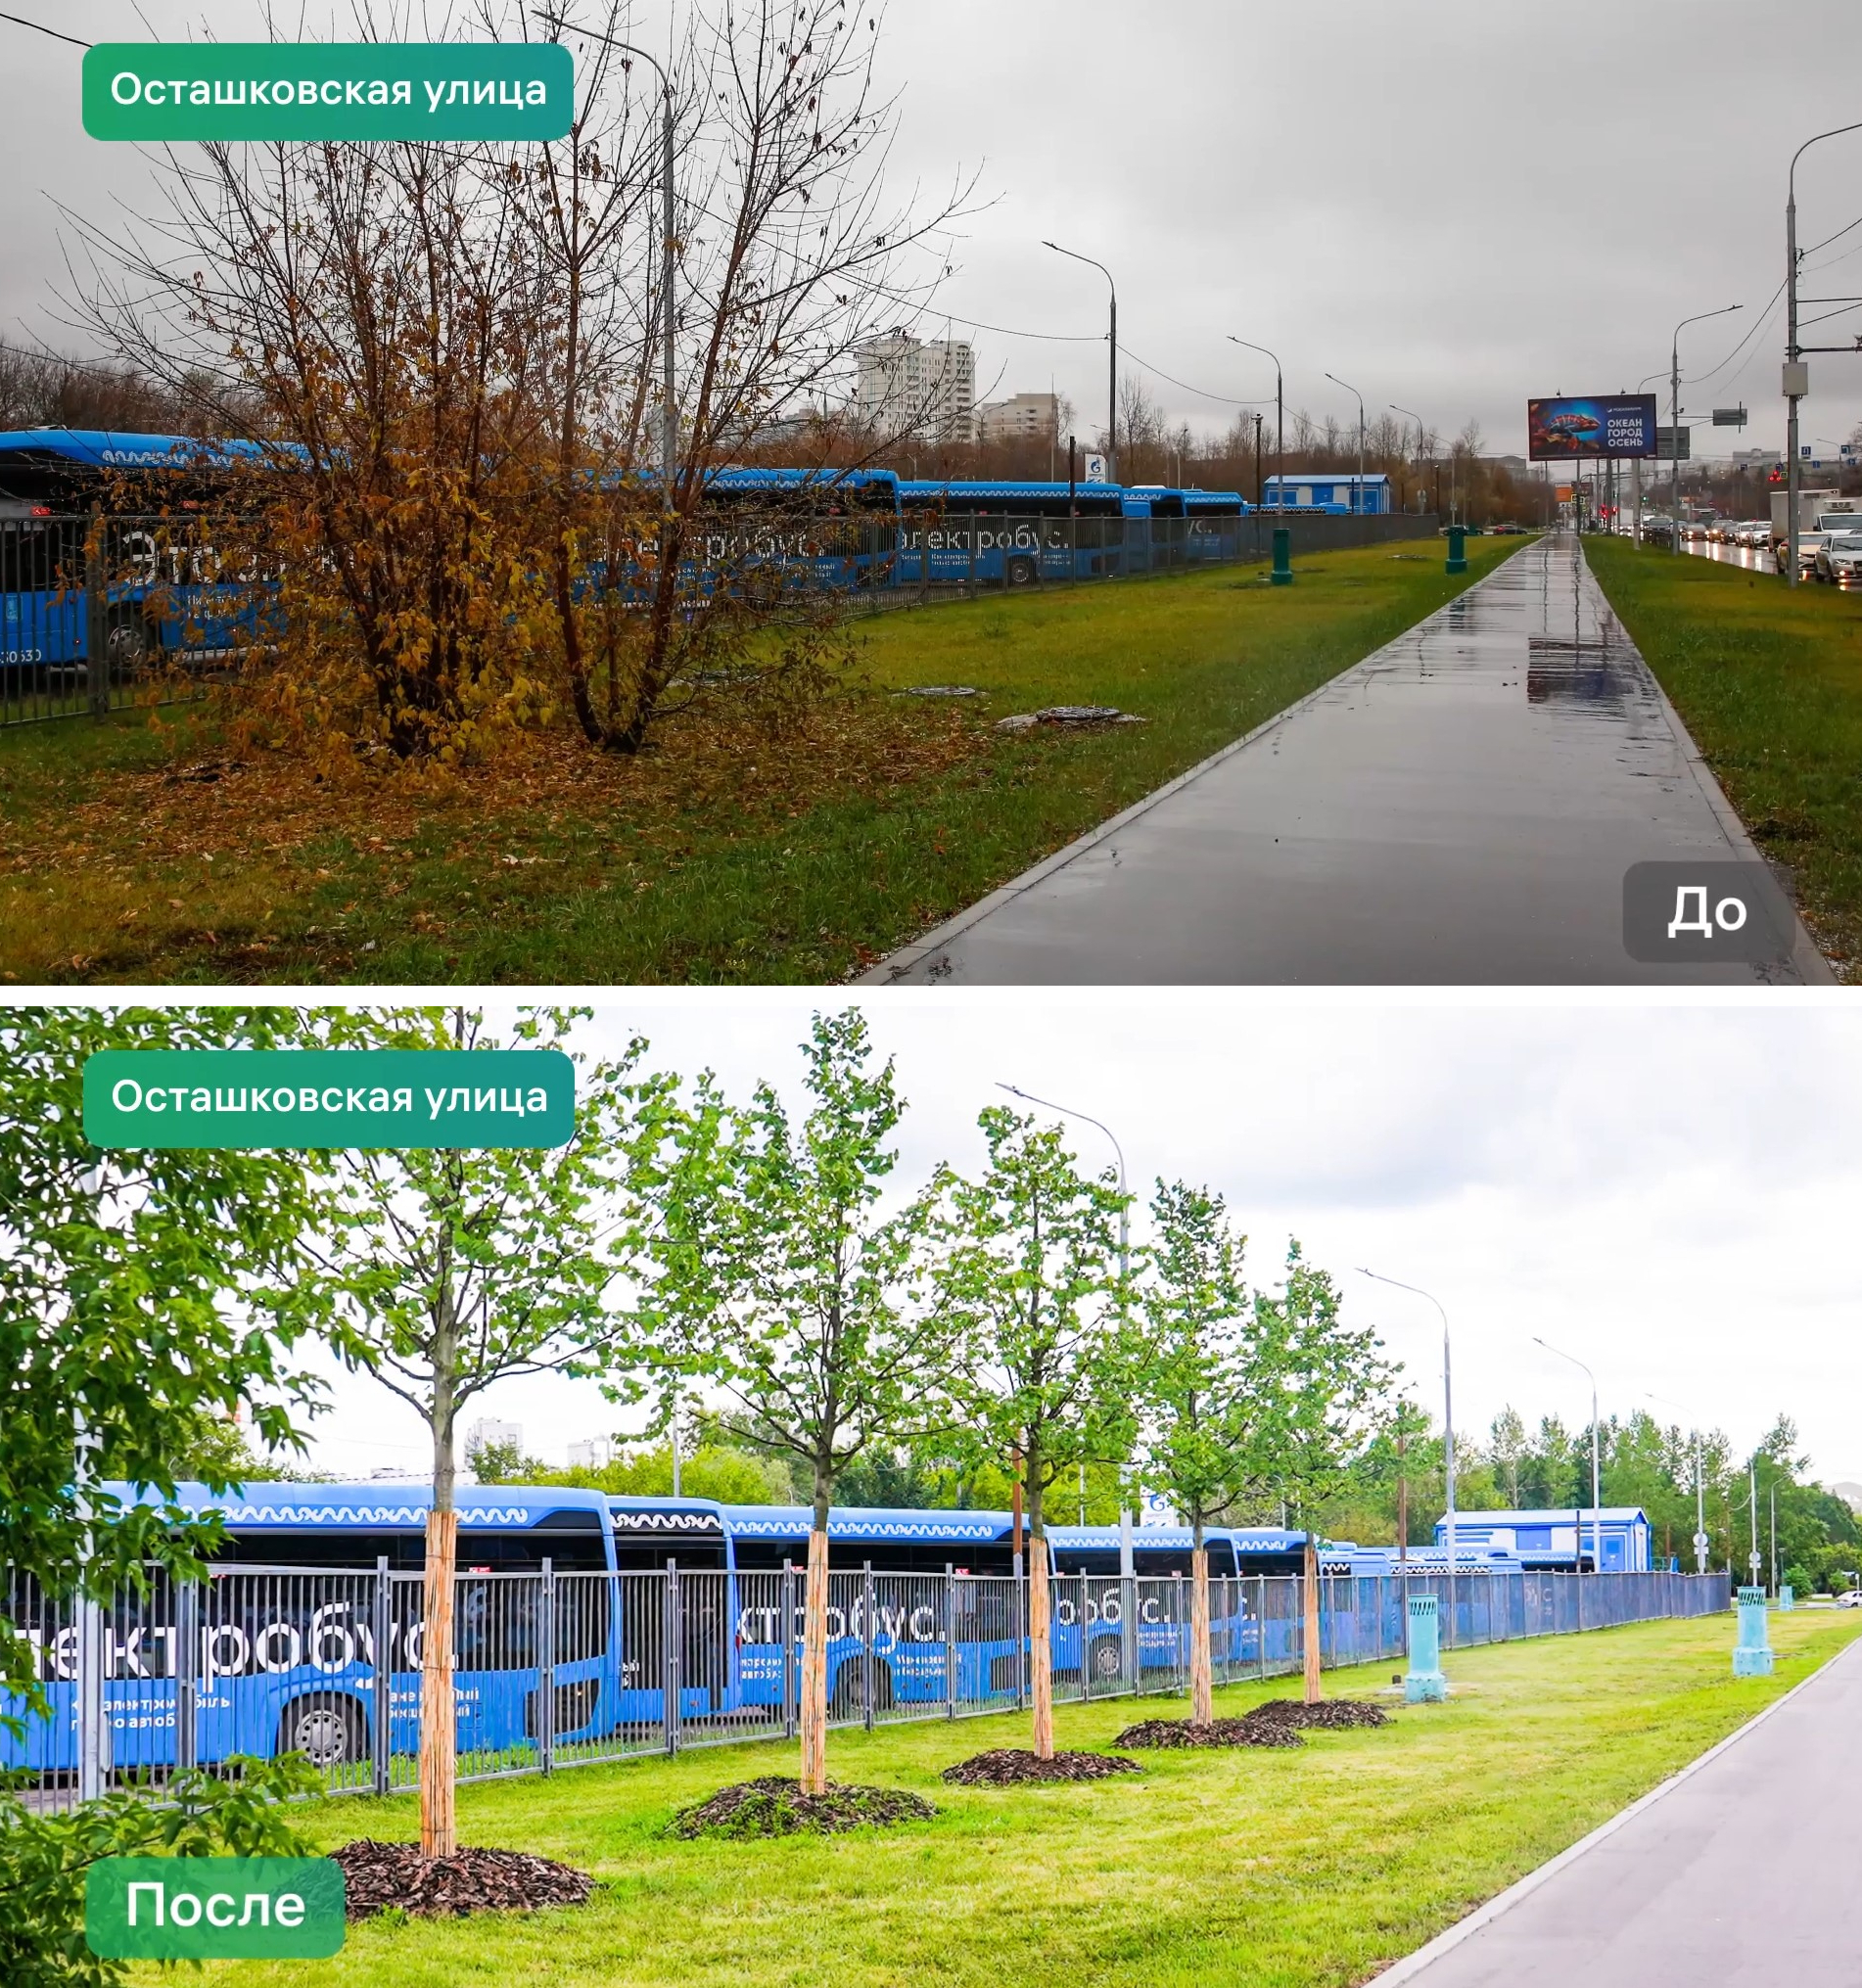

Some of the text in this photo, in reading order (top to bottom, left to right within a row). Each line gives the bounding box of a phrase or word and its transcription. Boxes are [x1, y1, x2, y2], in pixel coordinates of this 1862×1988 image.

[1606, 418, 1643, 428] ОКЕАН
[1607, 428, 1644, 439] ГОРОД
[1607, 438, 1644, 447] ОСЕНЬ
[104, 1694, 231, 1713] электромбиль
